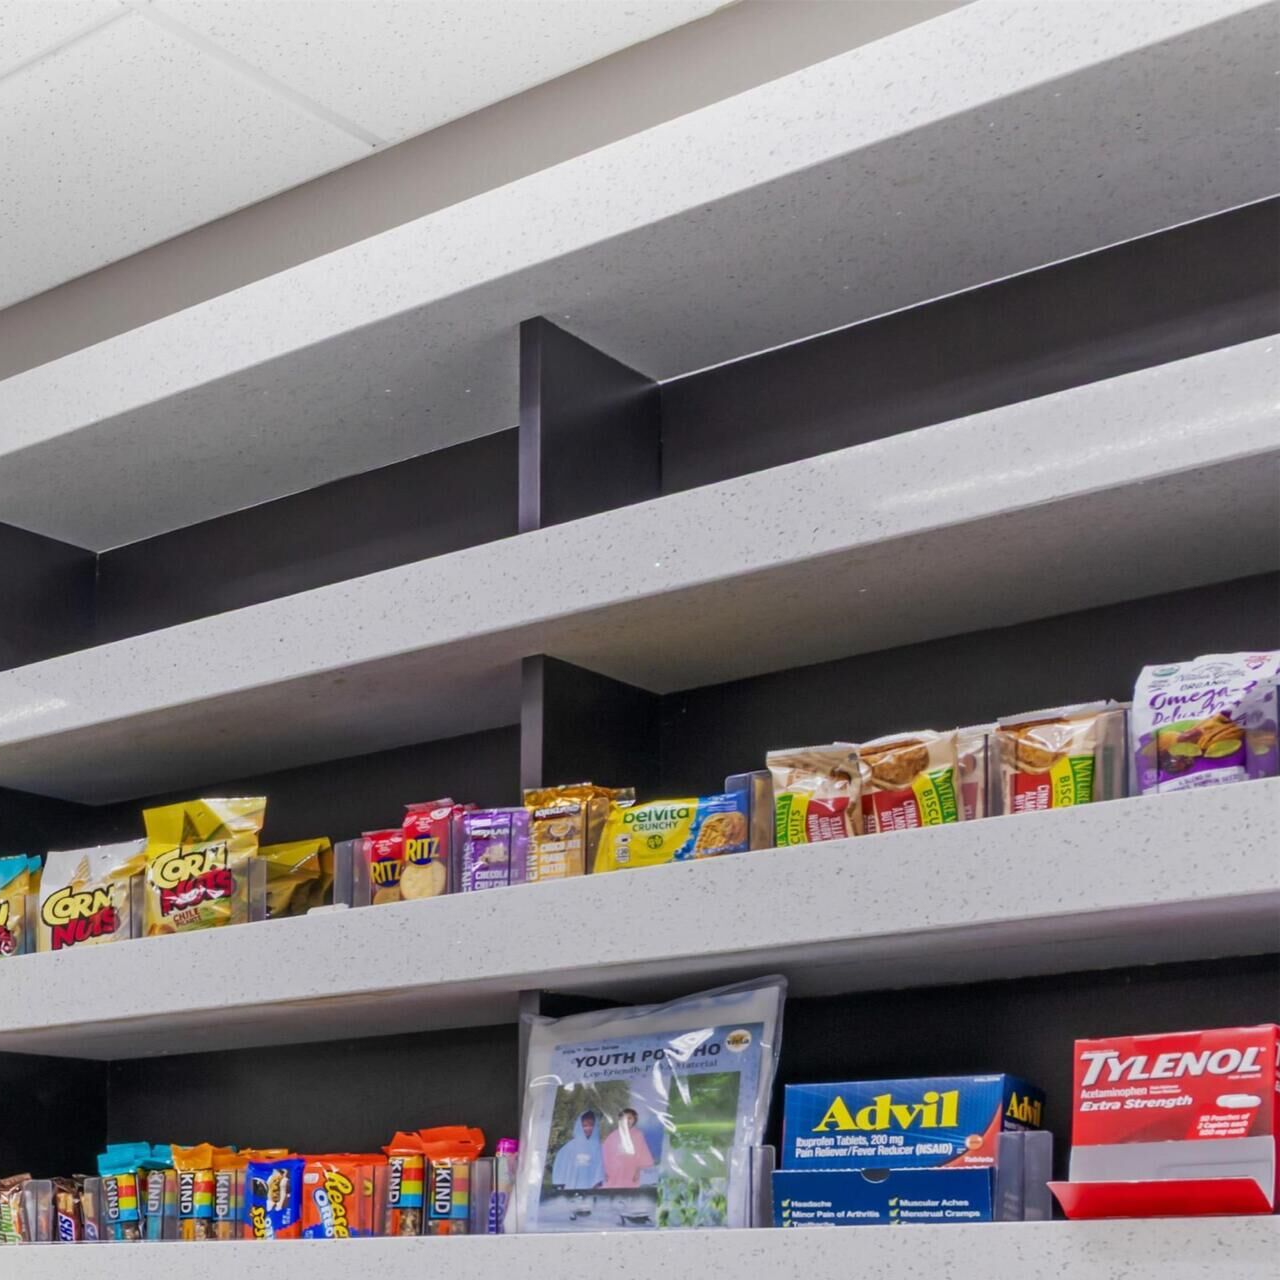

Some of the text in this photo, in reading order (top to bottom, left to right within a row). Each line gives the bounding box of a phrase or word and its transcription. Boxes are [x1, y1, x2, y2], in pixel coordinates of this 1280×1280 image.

[632, 820, 678, 833] CRUNCHY
[406, 837, 440, 861] RITZ
[149, 841, 226, 888] CORN
[371, 859, 402, 881] RITZ
[43, 883, 115, 924] CORN
[52, 906, 119, 950] NUTS
[576, 1043, 721, 1068] YOUTH POHO
[1080, 1047, 1262, 1087] TYLENOL
[1080, 1087, 1148, 1099] Acetaminophen
[1080, 1095, 1193, 1112] Extra Strength
[811, 1090, 959, 1132] Advil
[795, 1134, 904, 1149] Ibuprofen Tablets, 200 mg
[795, 1147, 814, 1158] Pain
[877, 1146, 913, 1156] Reducer
[915, 1142, 953, 1155] (NSAID)
[148, 1172, 164, 1212] KIND
[391, 1158, 402, 1202] KIND
[436, 1161, 450, 1214] KIND
[107, 1180, 119, 1219] KIND
[180, 1173, 194, 1214] KIND
[216, 1173, 228, 1216] KIND
[791, 1200, 832, 1208] Headache
[899, 1199, 969, 1207] Muscular Aches
[792, 1209, 880, 1218] Minor Pain of Arthritis
[900, 1209, 981, 1219] Menstrual Cramps
